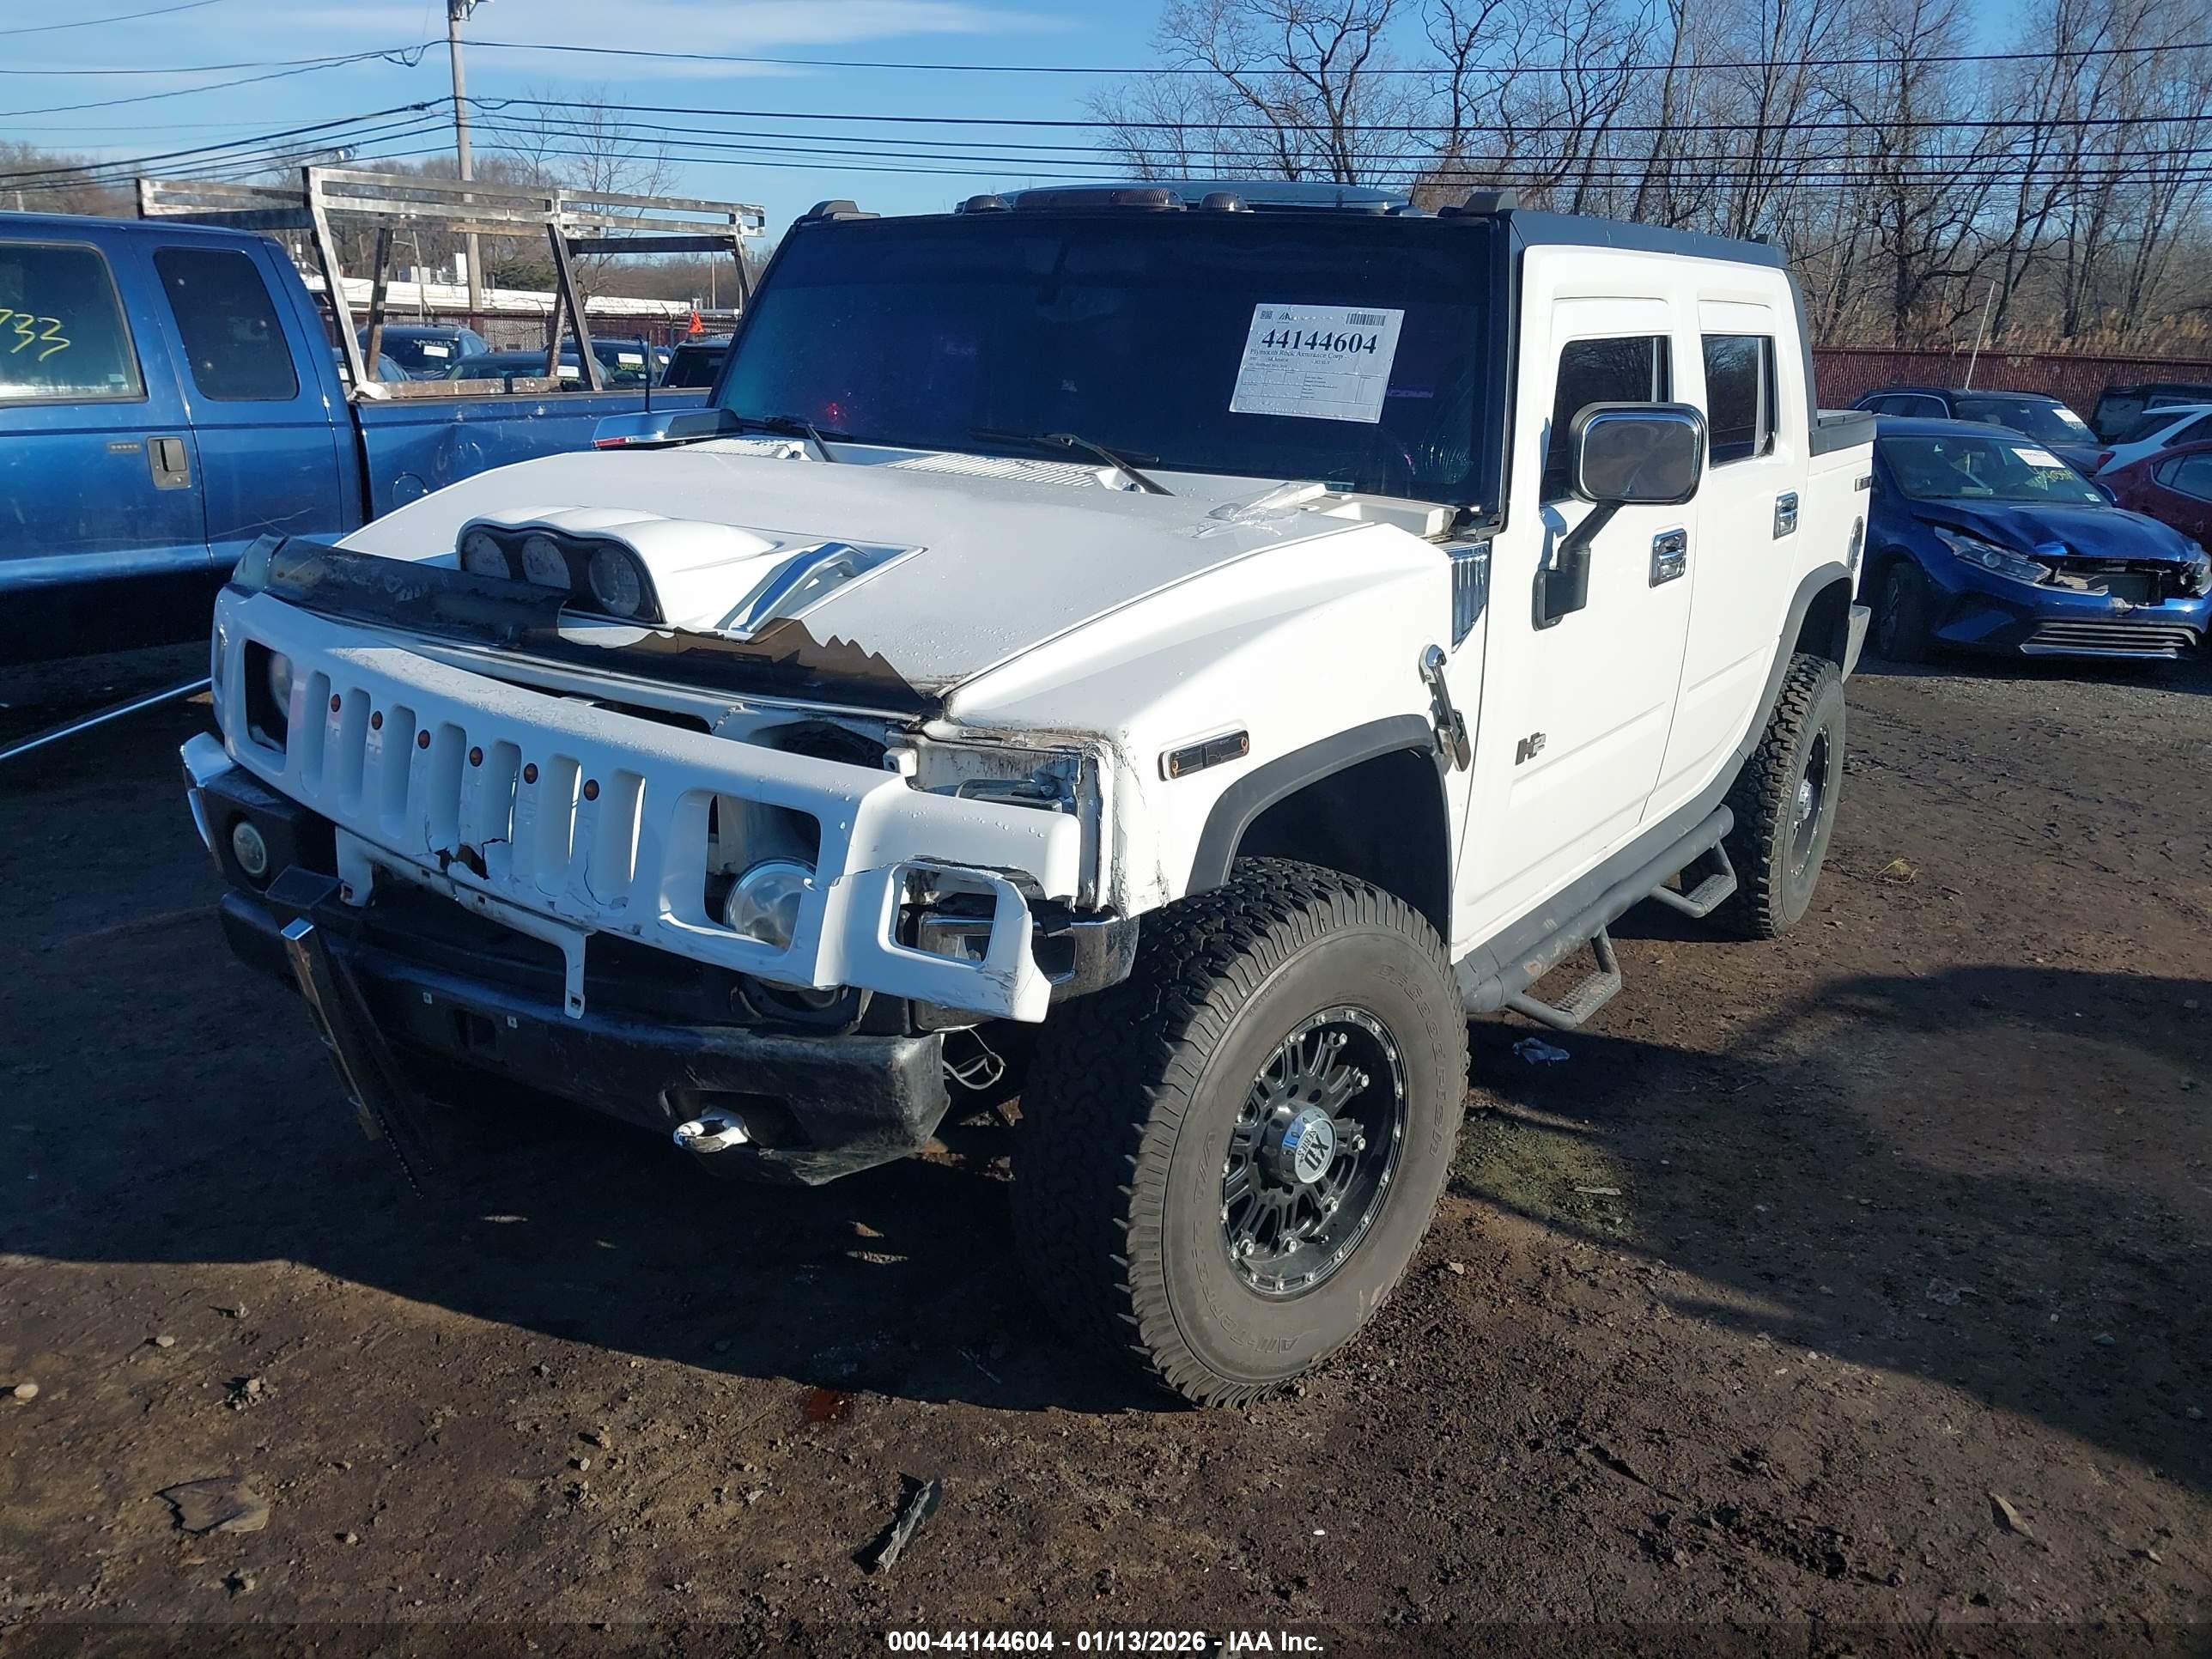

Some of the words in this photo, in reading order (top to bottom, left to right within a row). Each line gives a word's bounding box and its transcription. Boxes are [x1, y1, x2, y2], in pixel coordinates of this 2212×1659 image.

[1261, 328, 1377, 355] 44144604
[1515, 732, 1547, 766] H2
[1297, 1130, 1317, 1159] SERIES
